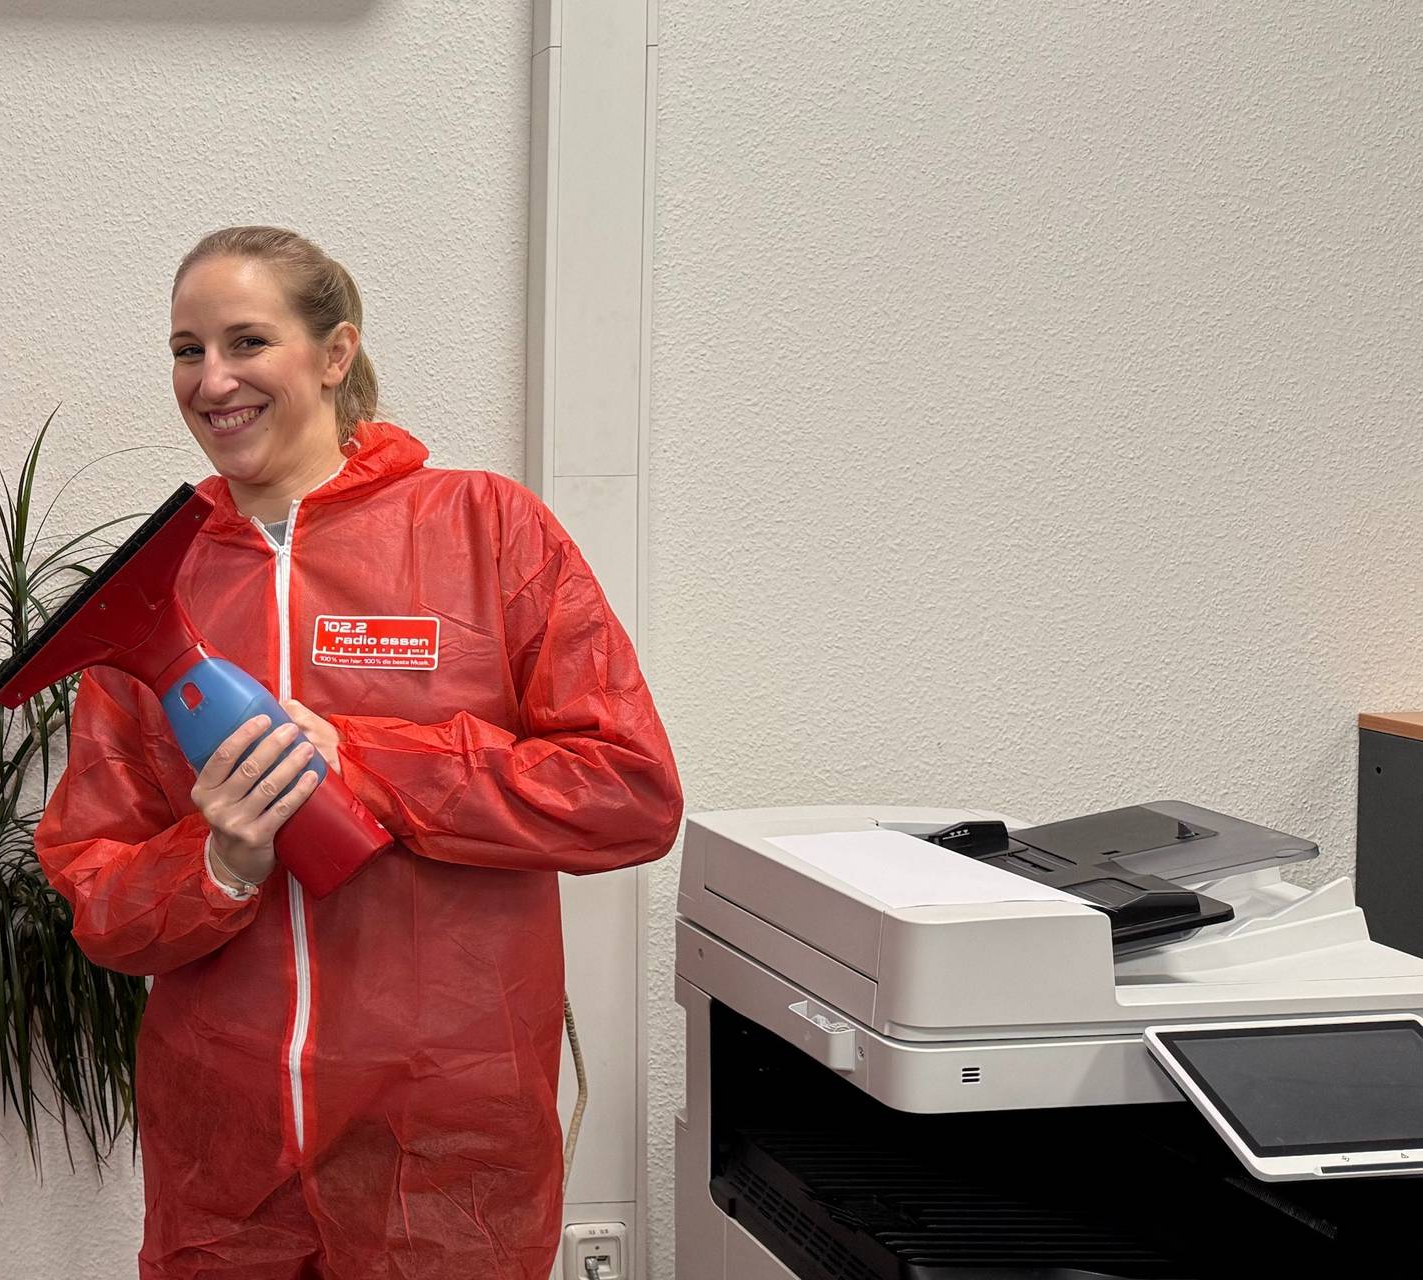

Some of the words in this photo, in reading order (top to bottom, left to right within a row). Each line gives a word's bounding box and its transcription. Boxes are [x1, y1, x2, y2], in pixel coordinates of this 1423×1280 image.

[323, 620, 368, 633] 102.2
[335, 635, 377, 645] radio
[380, 637, 429, 647] essen
